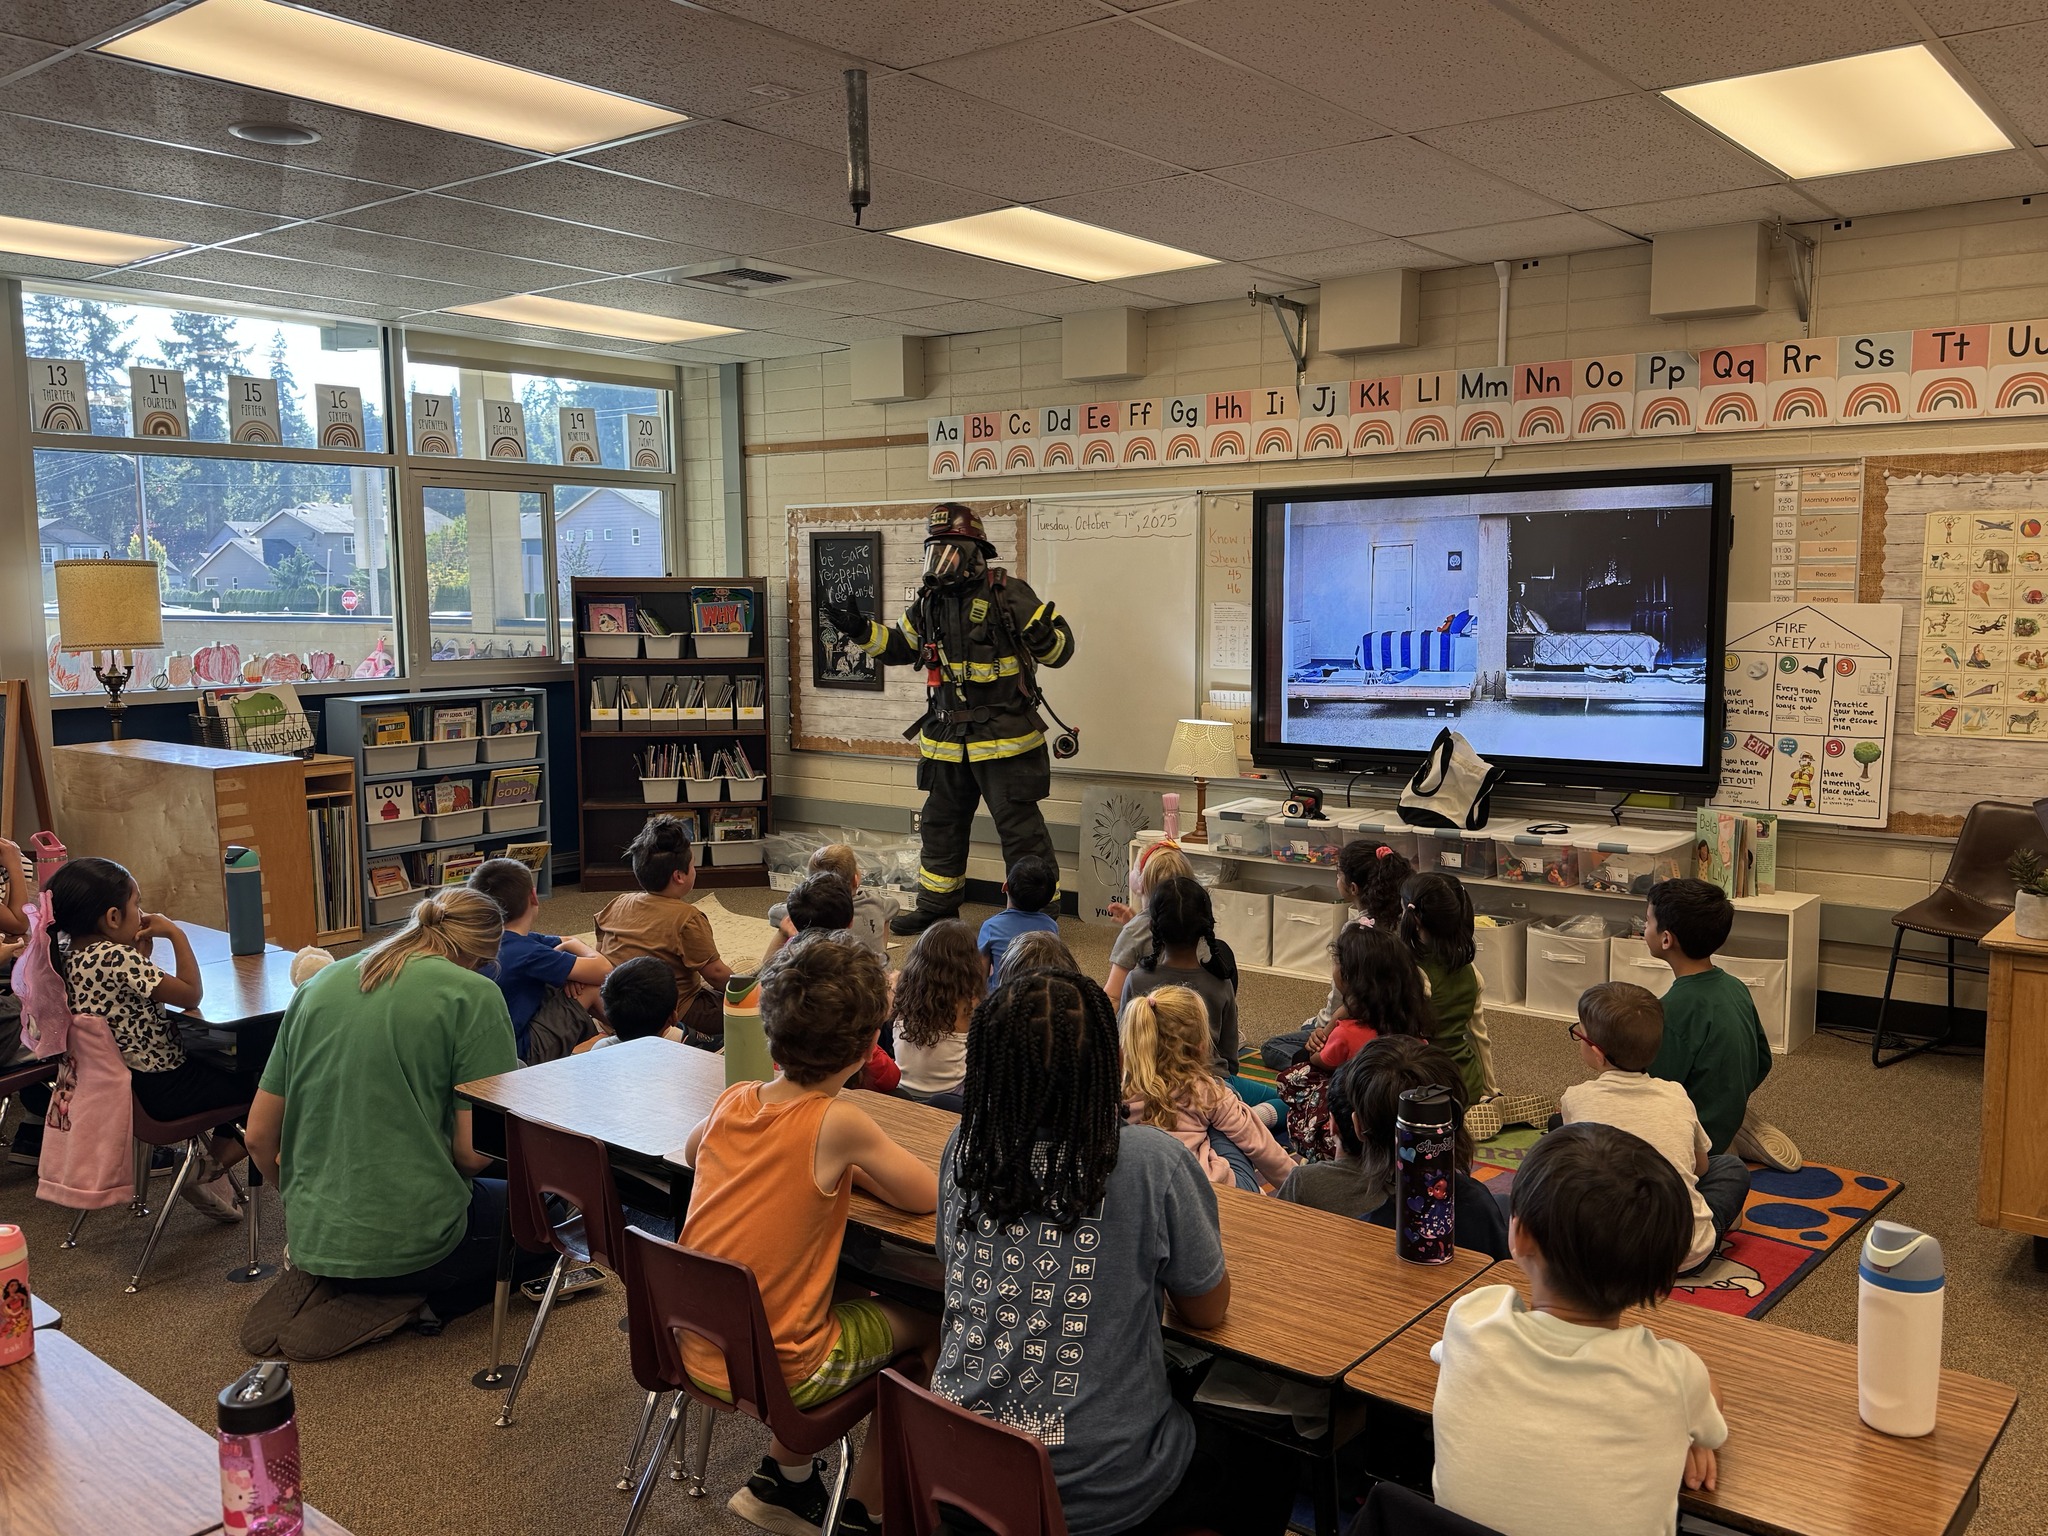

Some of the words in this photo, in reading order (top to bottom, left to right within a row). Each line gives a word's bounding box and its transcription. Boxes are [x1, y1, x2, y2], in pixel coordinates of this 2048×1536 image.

[48, 365, 67, 386] 13
[150, 374, 168, 394] 14
[936, 420, 958, 442] Aa
[972, 417, 994, 438] Bb
[1008, 414, 1031, 434] Cc
[1047, 410, 1071, 432] Dd
[1087, 407, 1110, 430] Ee
[1130, 403, 1153, 426] Ff
[1171, 400, 1198, 428] Gg
[1215, 396, 1242, 420] Hh
[1266, 391, 1284, 416] Ii
[1312, 386, 1336, 417] Jj
[1360, 382, 1390, 408] Kk
[1418, 376, 1440, 402] Ll
[1461, 372, 1508, 399] Mm
[1526, 367, 1561, 394] Nn
[1585, 361, 1623, 387] Oo
[1649, 357, 1686, 391] Pp
[1713, 350, 1755, 384] Qq
[1783, 345, 1821, 373] Rr
[1854, 339, 1895, 370] Ss
[1932, 331, 1970, 362] Tt
[42, 389, 76, 402] THIRTEEN
[244, 383, 262, 402] 15
[331, 390, 348, 408] 16
[143, 397, 177, 410] FOURTEEN
[241, 404, 266, 416] FIFTEEN
[425, 399, 439, 417] 17
[328, 411, 352, 422] SIXTEEN
[497, 406, 510, 423] 18
[570, 413, 585, 430] 19
[418, 418, 448, 431] SEVENTEEN
[493, 424, 518, 436] EIGHTEEN
[639, 420, 652, 436] 20
[568, 431, 590, 442] NINETEEN
[1075, 514, 1111, 530] October
[1142, 513, 1178, 529] 2025
[1209, 528, 1238, 544] Know
[820, 546, 834, 568] be
[1210, 550, 1238, 564] Show
[1228, 570, 1242, 580] 45
[1227, 583, 1241, 594] 46
[343, 596, 356, 604] STOP
[701, 604, 738, 626] WHY
[1776, 622, 1807, 634] FIRE
[1768, 636, 1816, 650] SAFETY
[1834, 640, 1860, 650] home
[1776, 684, 1798, 696] Every
[1802, 687, 1821, 696] room
[1726, 698, 1754, 708] orking
[1834, 700, 1868, 708] Practice
[1743, 708, 1769, 717] alarms
[1834, 708, 1850, 717] your
[1850, 717, 1878, 725] escape
[252, 728, 309, 753] DINOSAUR
[1723, 736, 1730, 744] 4
[1748, 738, 1769, 756] EXIT
[1830, 744, 1838, 752] 5
[1742, 768, 1763, 776] alarm
[1824, 770, 1844, 778] Have
[375, 785, 404, 799] LOU
[497, 786, 531, 798] GOOP!
[1829, 780, 1860, 791] meeting
[1700, 814, 1718, 834] Bela
[1712, 863, 1728, 888] Lily
[984, 1220, 990, 1230] 9
[1044, 1229, 1058, 1241] 11
[1079, 1233, 1094, 1244] 12
[956, 1241, 966, 1253] 14
[978, 1248, 989, 1260] 15
[1006, 1254, 1019, 1266] 16
[1039, 1260, 1054, 1270] 17
[1075, 1264, 1090, 1274] 18
[976, 1277, 988, 1289] 21
[1001, 1283, 1018, 1296] 22
[1034, 1288, 1050, 1300] 23
[1068, 1292, 1088, 1302] 24
[972, 1306, 984, 1317] 27
[1000, 1312, 1016, 1322] 28
[1030, 1318, 1046, 1330] 29
[1066, 1320, 1084, 1332] 30
[968, 1333, 982, 1344] 33
[996, 1340, 1010, 1350] 34
[1026, 1345, 1042, 1356] 35
[1061, 1348, 1078, 1360] 36
